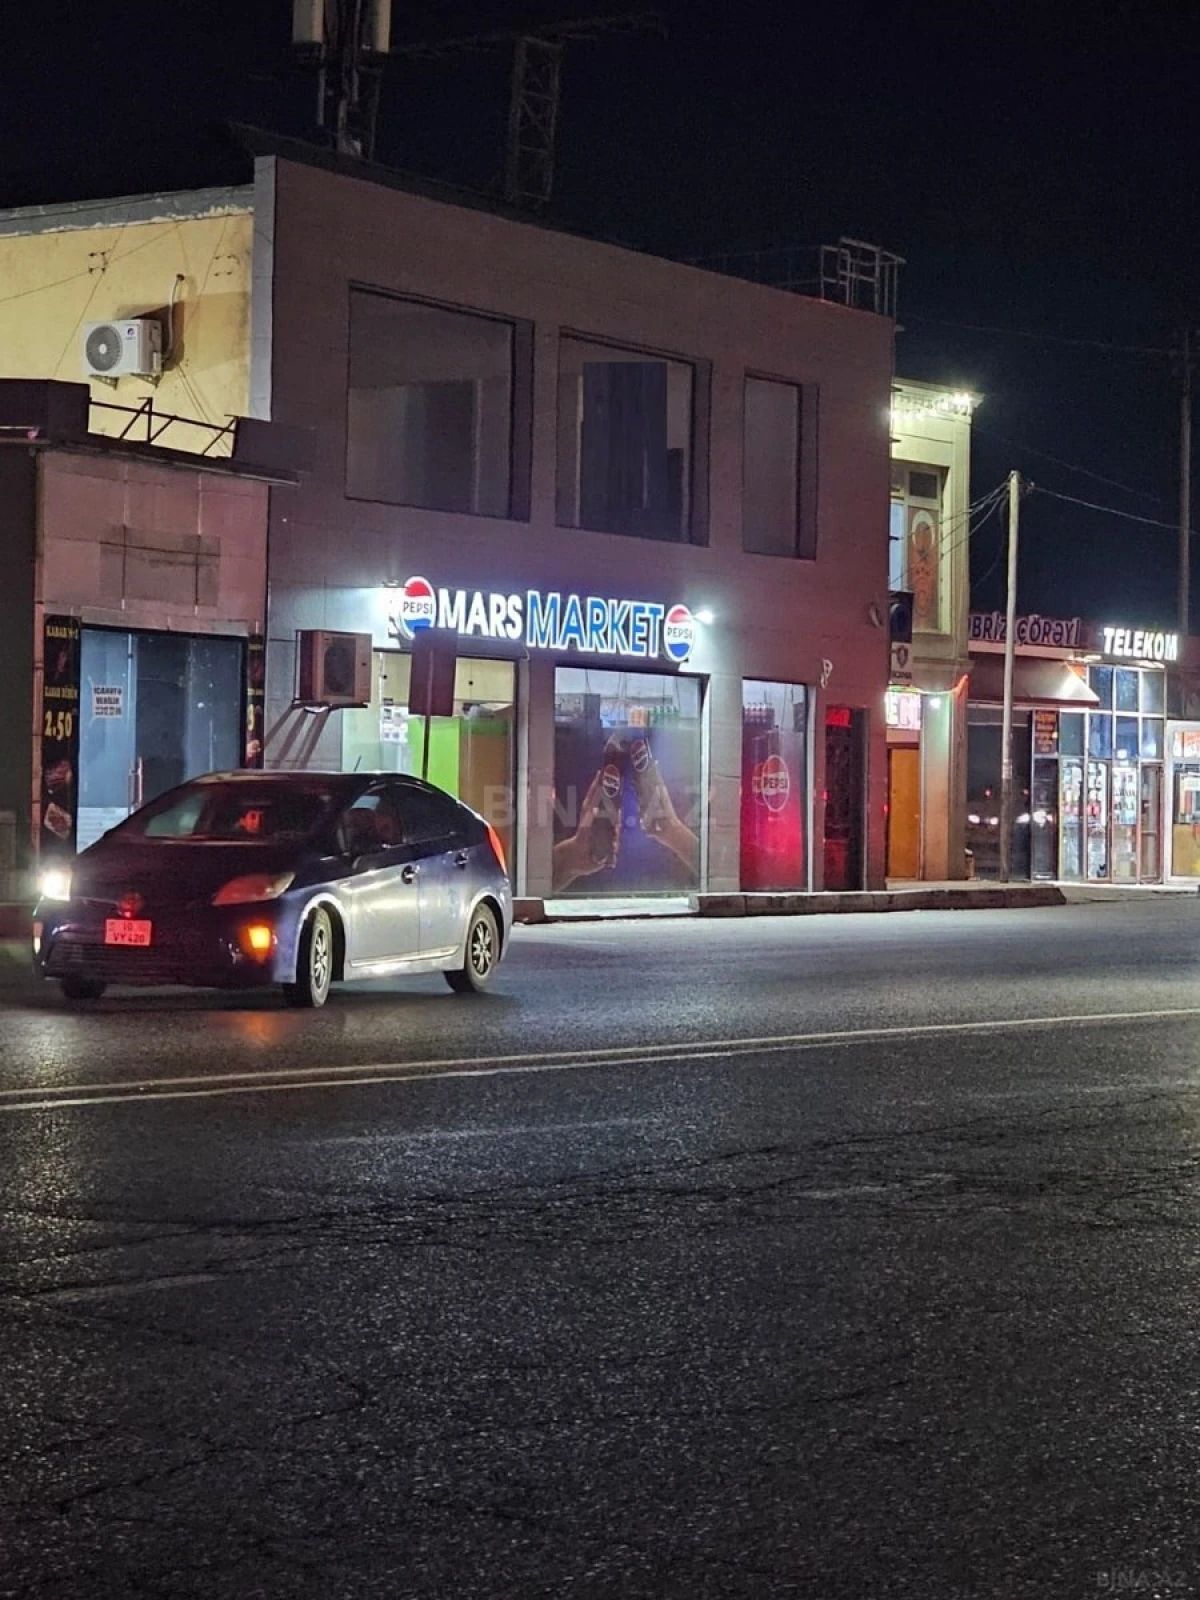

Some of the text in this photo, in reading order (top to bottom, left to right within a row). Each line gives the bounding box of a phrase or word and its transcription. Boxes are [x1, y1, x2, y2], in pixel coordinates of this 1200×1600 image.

[403, 600, 433, 614] PEPSI
[438, 588, 664, 658] MARS MARKET
[667, 626, 693, 640] PEPSI
[1103, 627, 1178, 661] TELEKOM
[44, 710, 73, 740] 2.50
